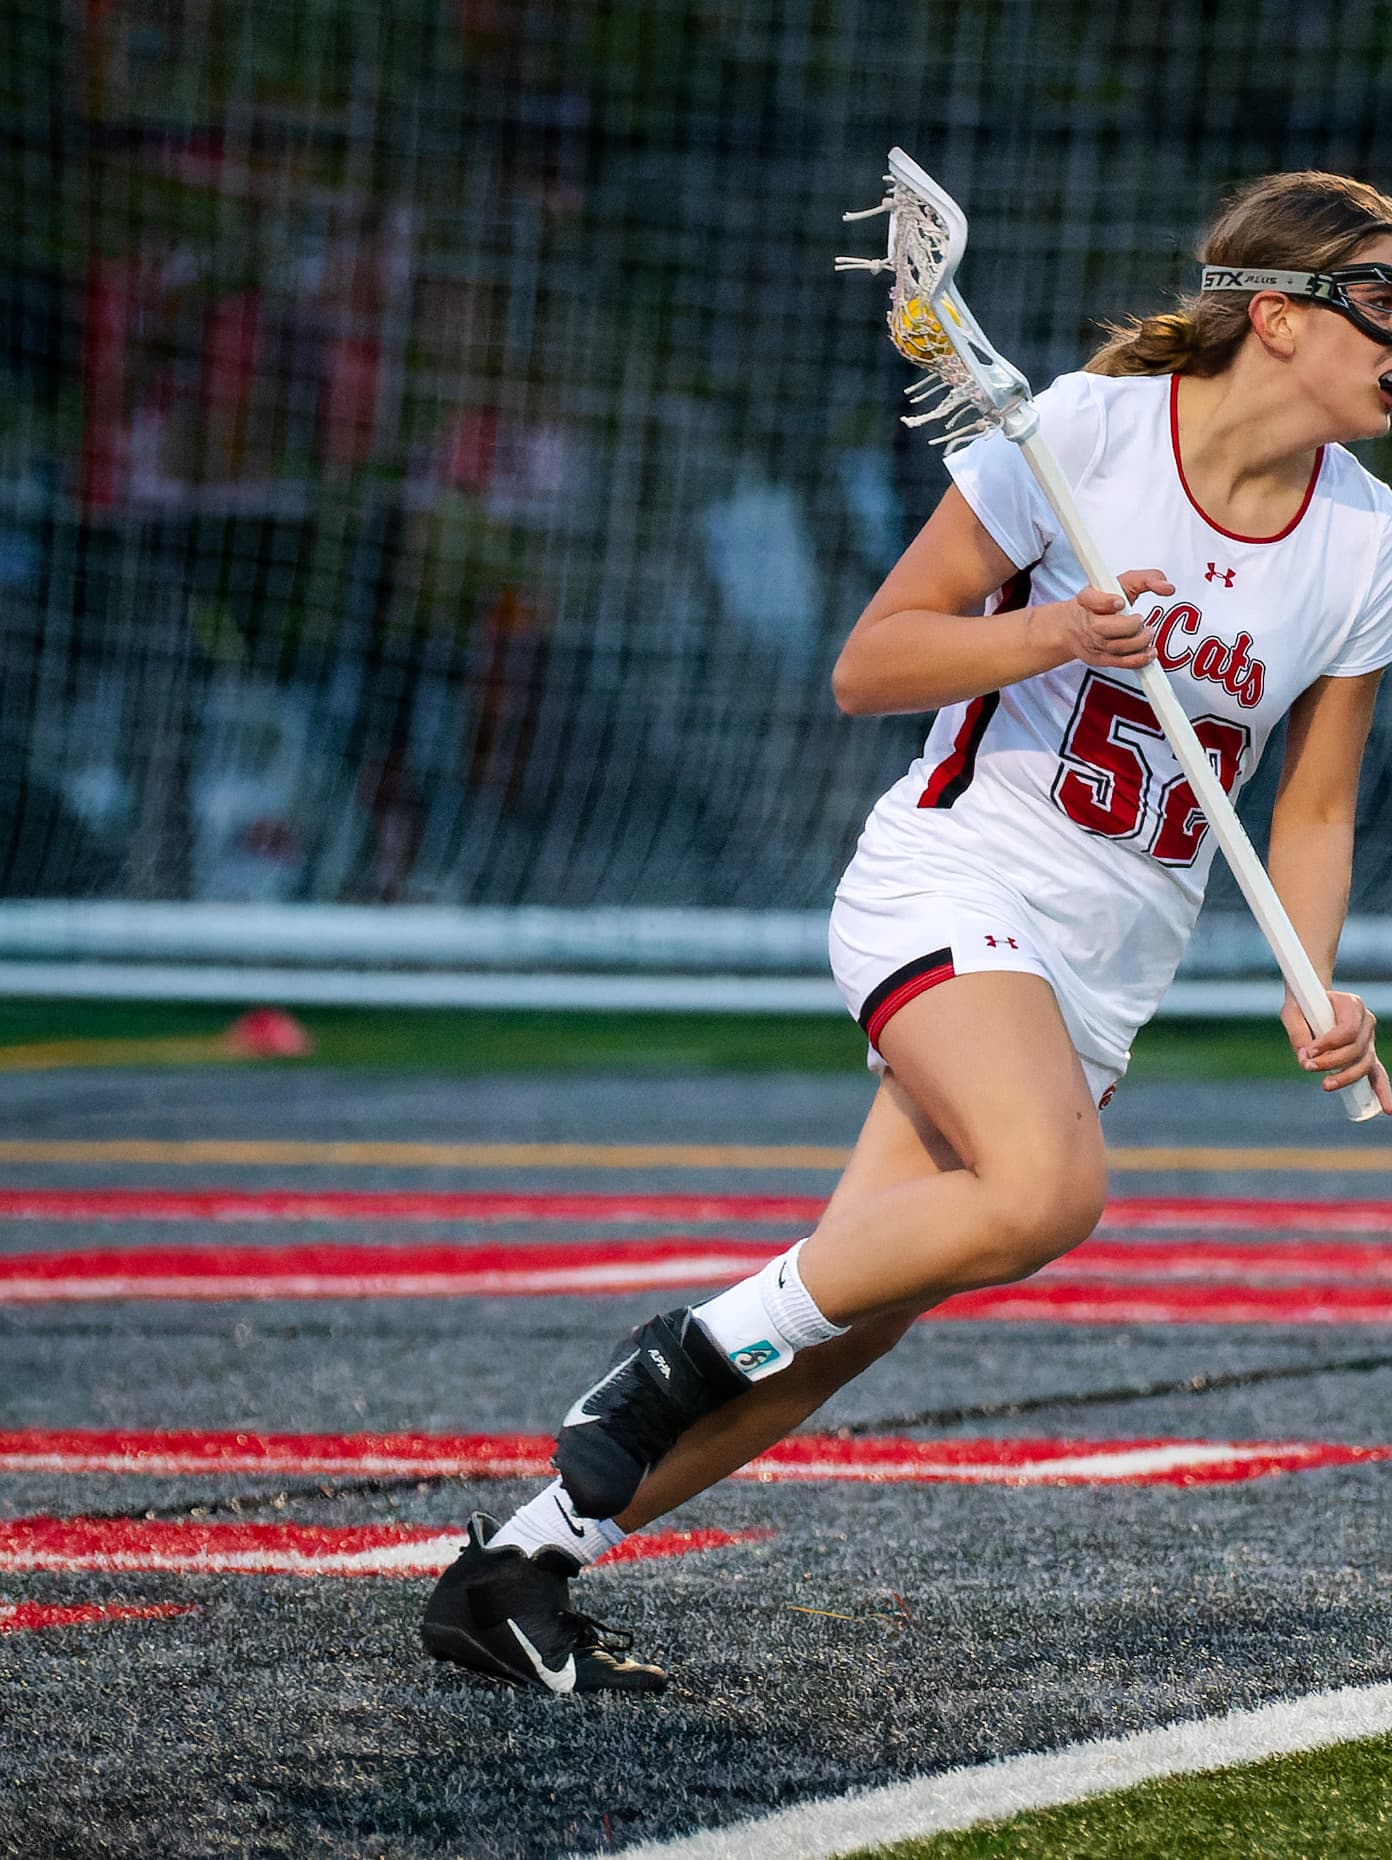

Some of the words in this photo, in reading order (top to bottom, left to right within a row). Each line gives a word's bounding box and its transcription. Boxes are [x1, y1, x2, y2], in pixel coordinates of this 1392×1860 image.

[1203, 271, 1244, 288] STX
[1244, 274, 1278, 285] PLUS
[1144, 601, 1266, 709] Cats
[1050, 668, 1252, 869] 52
